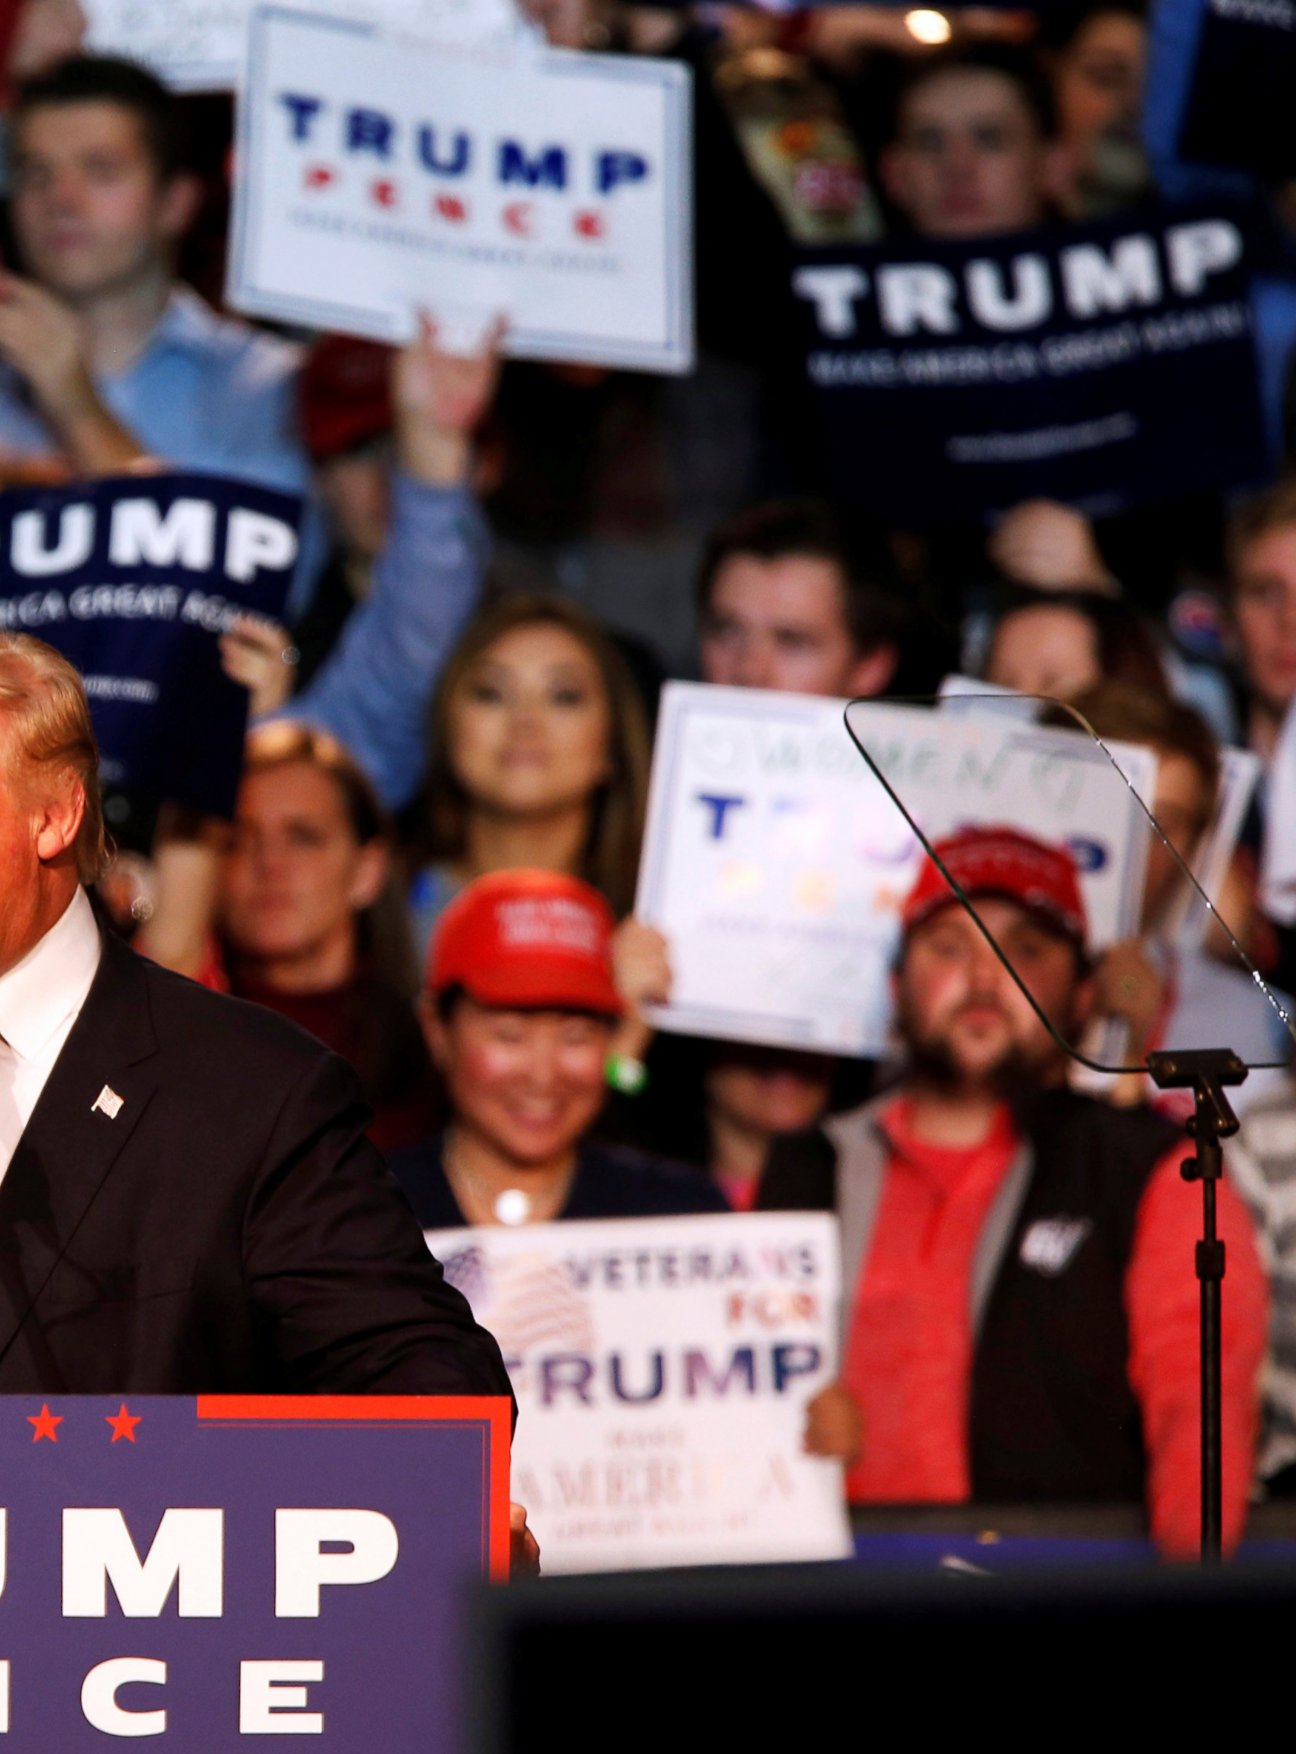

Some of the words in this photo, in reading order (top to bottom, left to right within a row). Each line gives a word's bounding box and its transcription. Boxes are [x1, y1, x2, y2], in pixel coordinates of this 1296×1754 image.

[279, 92, 650, 197] TRUMP
[302, 160, 609, 243] PENCE
[792, 218, 1244, 340] TRUMP
